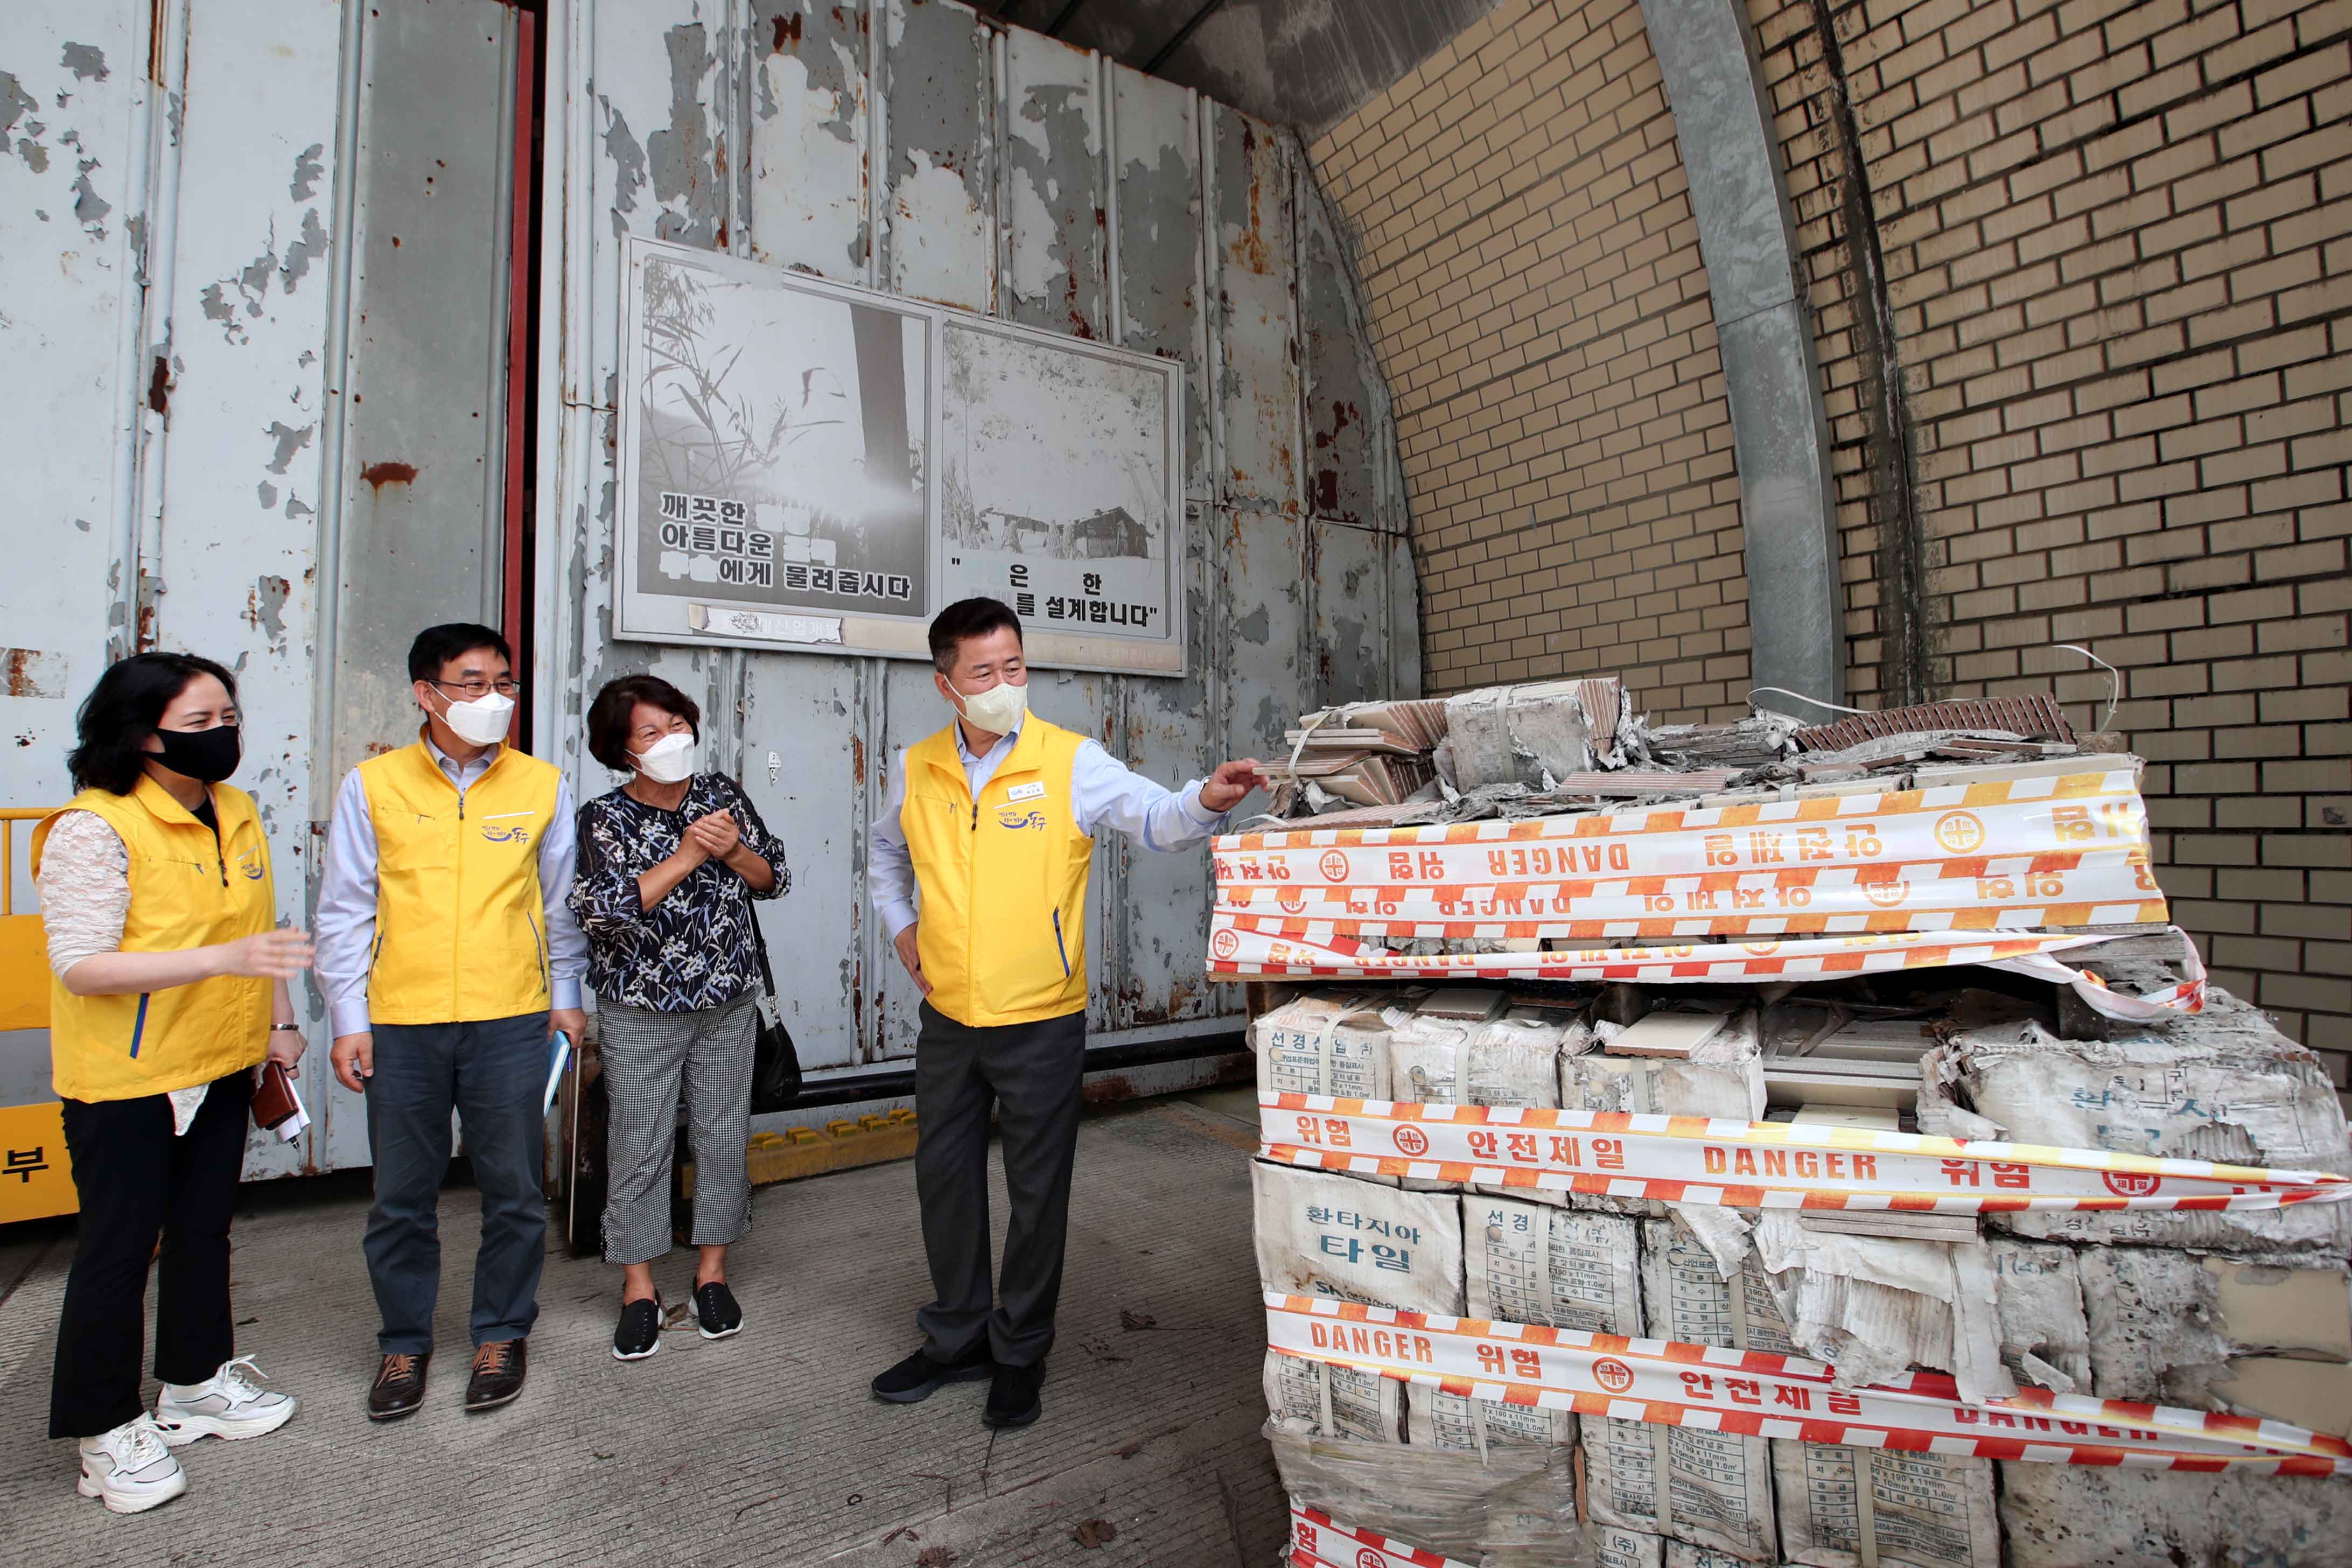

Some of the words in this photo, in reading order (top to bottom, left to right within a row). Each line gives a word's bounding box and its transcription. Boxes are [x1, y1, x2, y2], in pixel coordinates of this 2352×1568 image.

[662, 494, 746, 526] 깨끗한
[662, 523, 773, 557] 아름다운
[785, 564, 910, 599] 물려줍시다
[1010, 564, 1028, 588] 은
[1083, 573, 1102, 596] 한
[1017, 592, 1035, 617] 를
[1045, 596, 1158, 627] 설계합니다"
[1487, 843, 1630, 876] DANGER
[1704, 823, 1883, 867] 안전제일
[1388, 851, 1445, 880] 위험
[1296, 1115, 1352, 1147] 위험
[1466, 1130, 1625, 1170] 안전제일
[2, 1146, 49, 1183] 부
[1703, 1146, 1878, 1181] DANGER
[1306, 1206, 1421, 1245] 환타지아
[1320, 1234, 1411, 1274] 타일
[1310, 1321, 1433, 1364] DANGER
[1476, 1343, 1542, 1380] 위험
[1678, 1371, 1861, 1416] 안전제일
[1704, 1451, 1727, 1462] 11mm
[1291, 1522, 1317, 1554] 험
[1612, 1535, 1637, 1555] (주)
